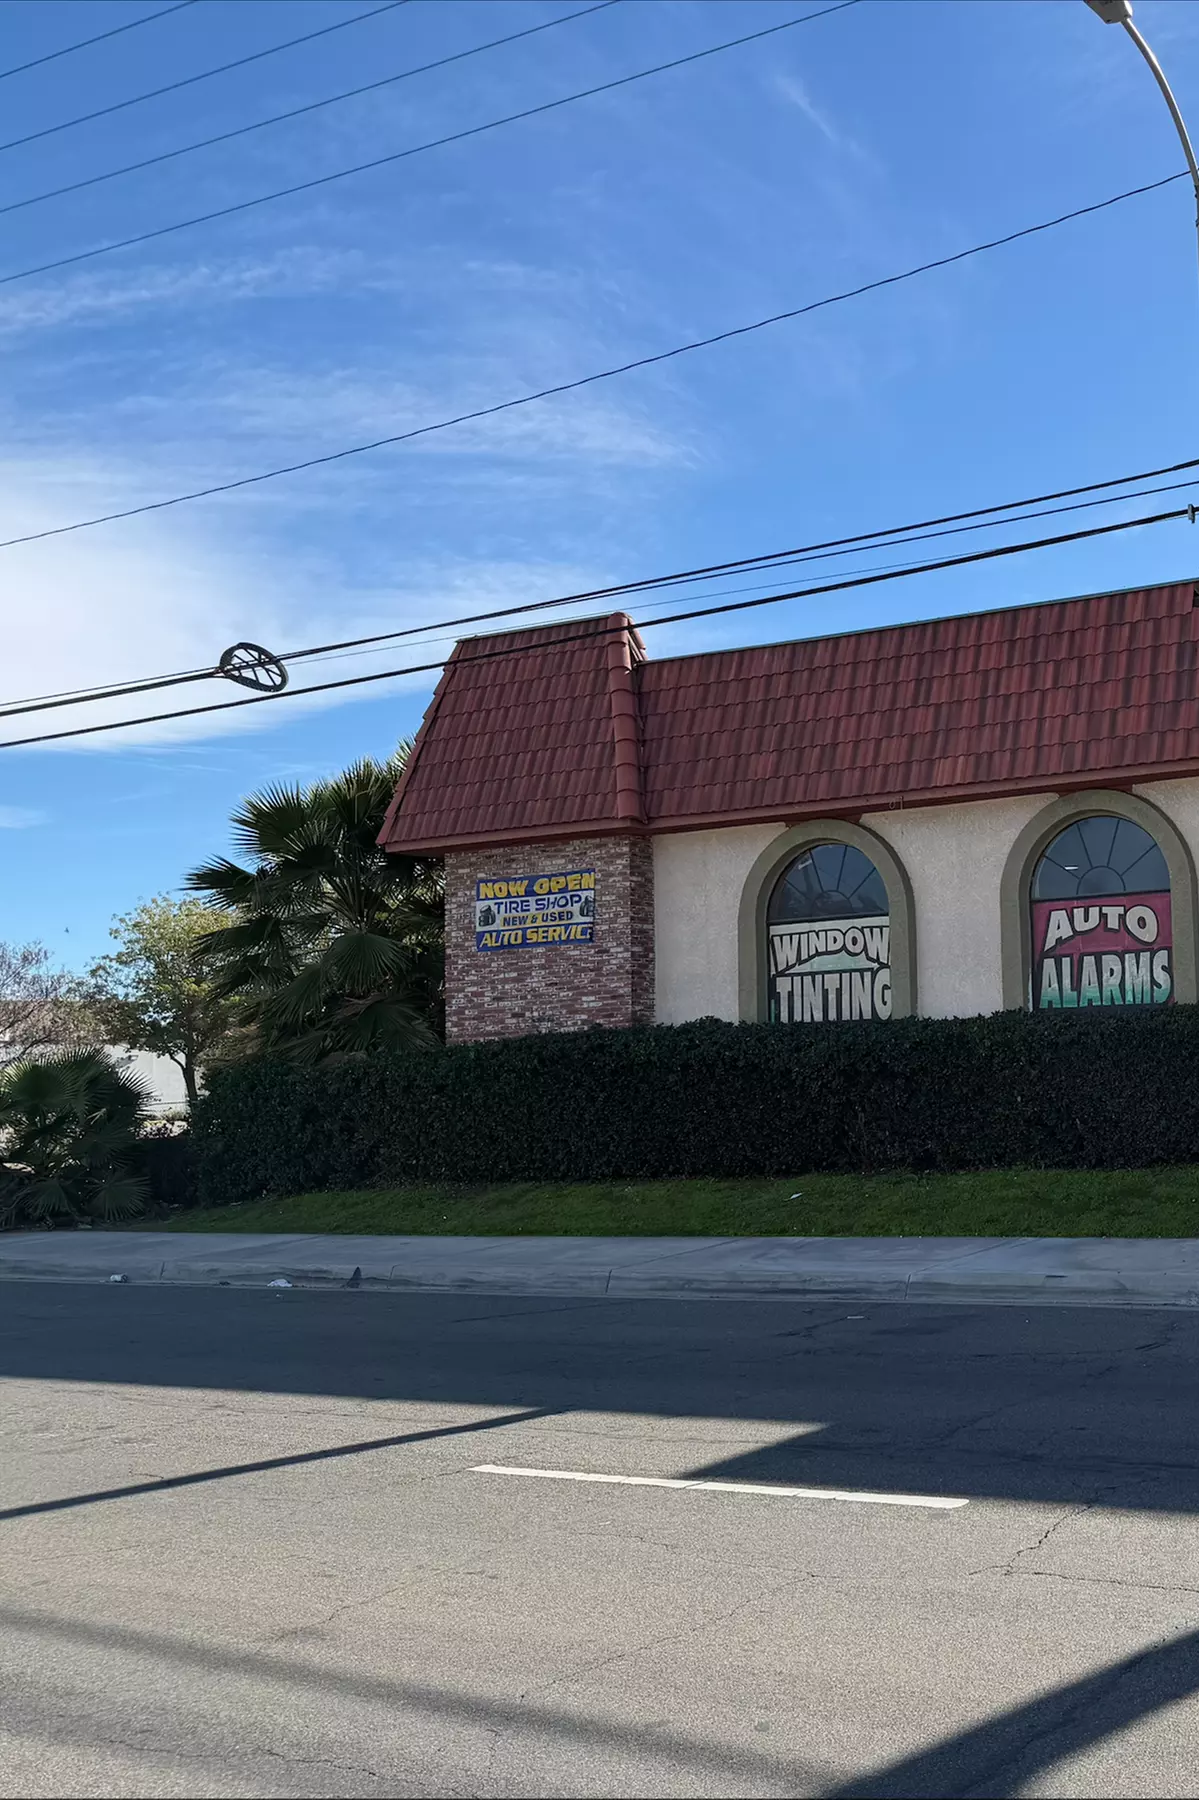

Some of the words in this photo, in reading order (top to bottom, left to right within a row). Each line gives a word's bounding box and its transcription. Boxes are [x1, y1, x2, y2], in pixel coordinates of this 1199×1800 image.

[480, 880, 529, 899] NOW
[533, 872, 595, 894] OPEN
[494, 899, 530, 915] TIRE
[535, 893, 582, 911] SHOP
[503, 915, 528, 928] NEW
[530, 914, 538, 924] &
[541, 910, 574, 923] USED
[1042, 904, 1160, 954] AUTO
[479, 930, 522, 948] AUTO
[770, 926, 890, 974] WINDOW
[773, 967, 893, 1024] TINTING
[1037, 948, 1173, 1009] ALARMS
